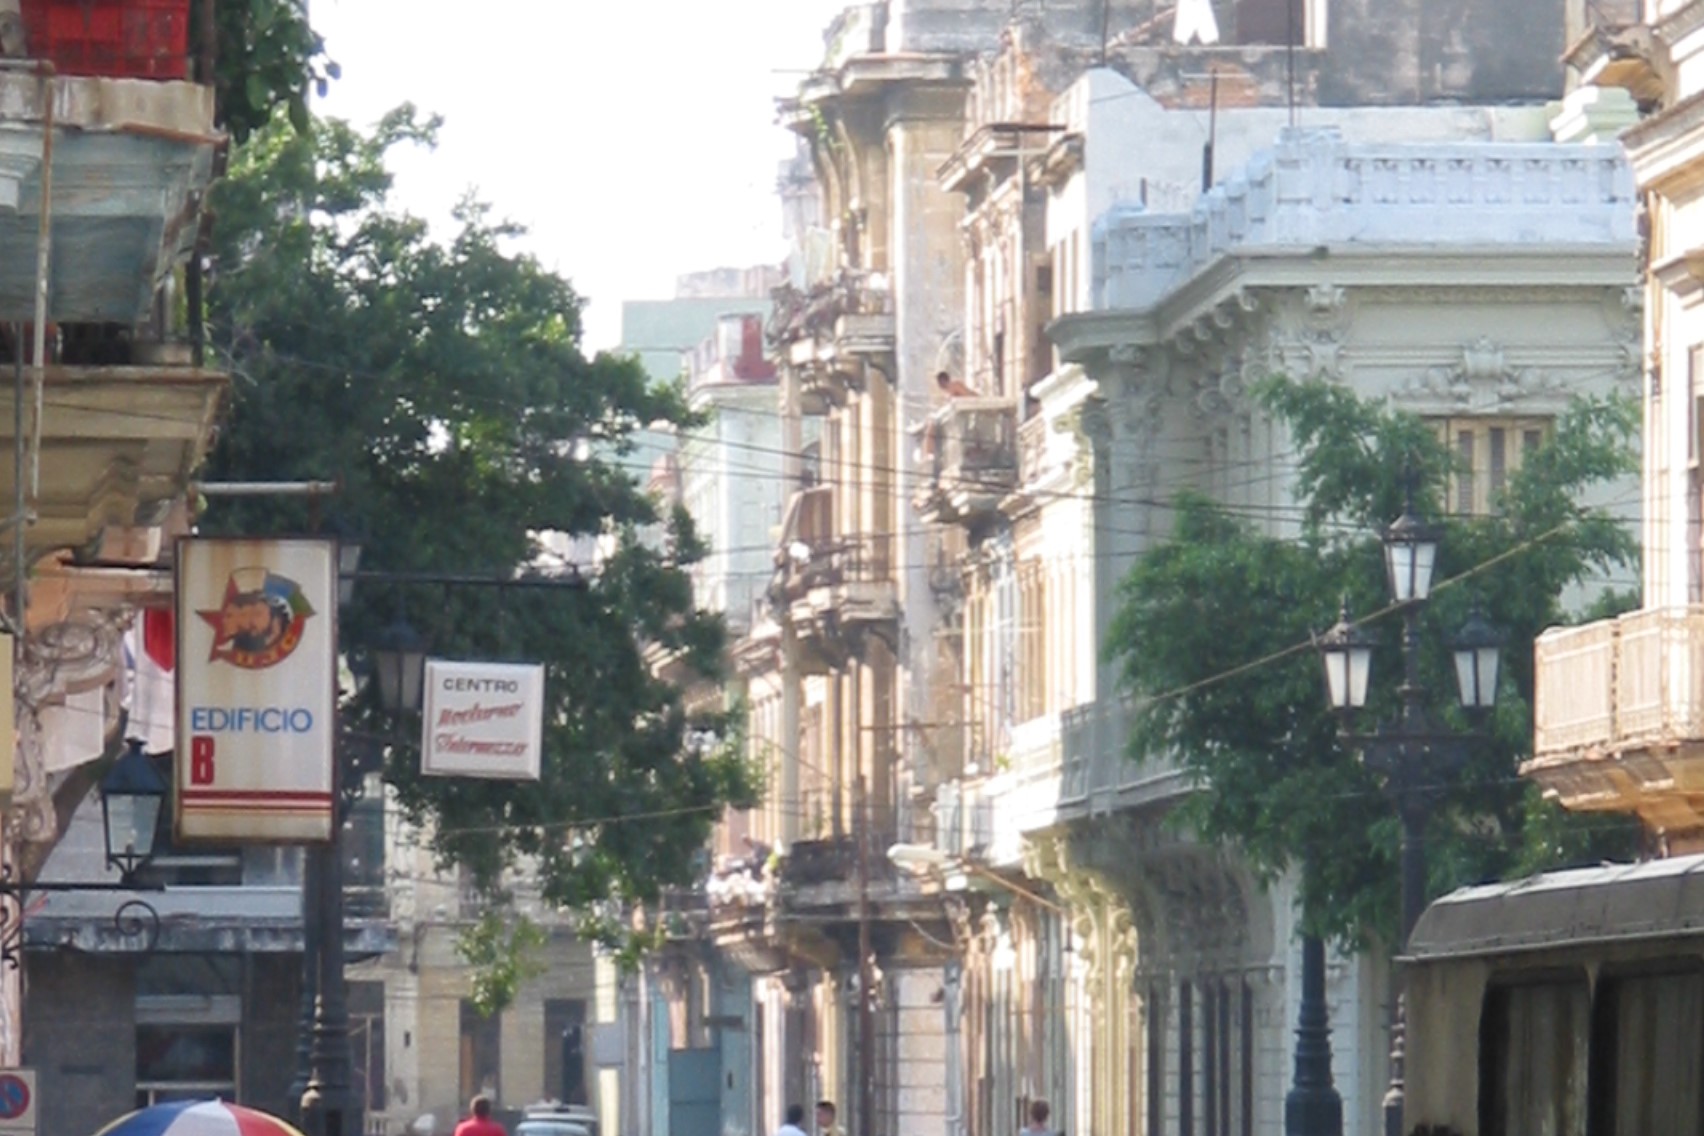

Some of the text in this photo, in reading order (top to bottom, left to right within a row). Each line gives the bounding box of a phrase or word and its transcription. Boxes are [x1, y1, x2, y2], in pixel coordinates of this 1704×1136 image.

[443, 678, 518, 693] CENTRO
[192, 707, 313, 733] EDIFICIO
[191, 735, 215, 785] B
